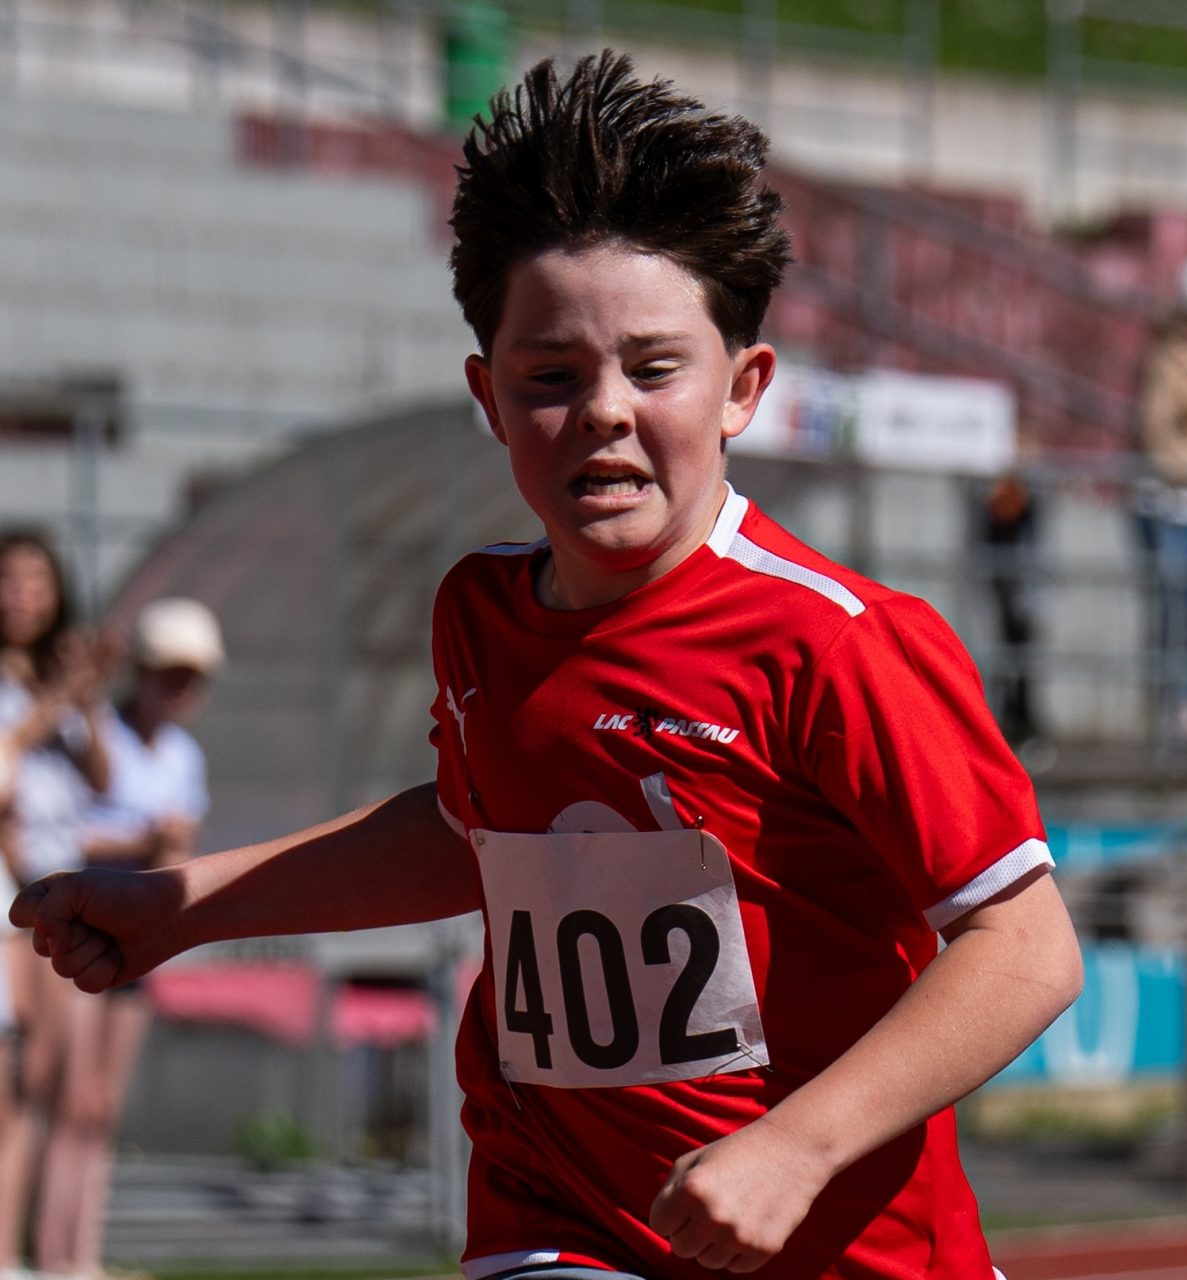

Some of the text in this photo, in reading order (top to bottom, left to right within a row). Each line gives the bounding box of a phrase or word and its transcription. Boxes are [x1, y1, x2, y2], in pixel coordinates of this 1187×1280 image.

[593, 713, 740, 744] LAC PASSAU
[504, 903, 738, 1070] 402
